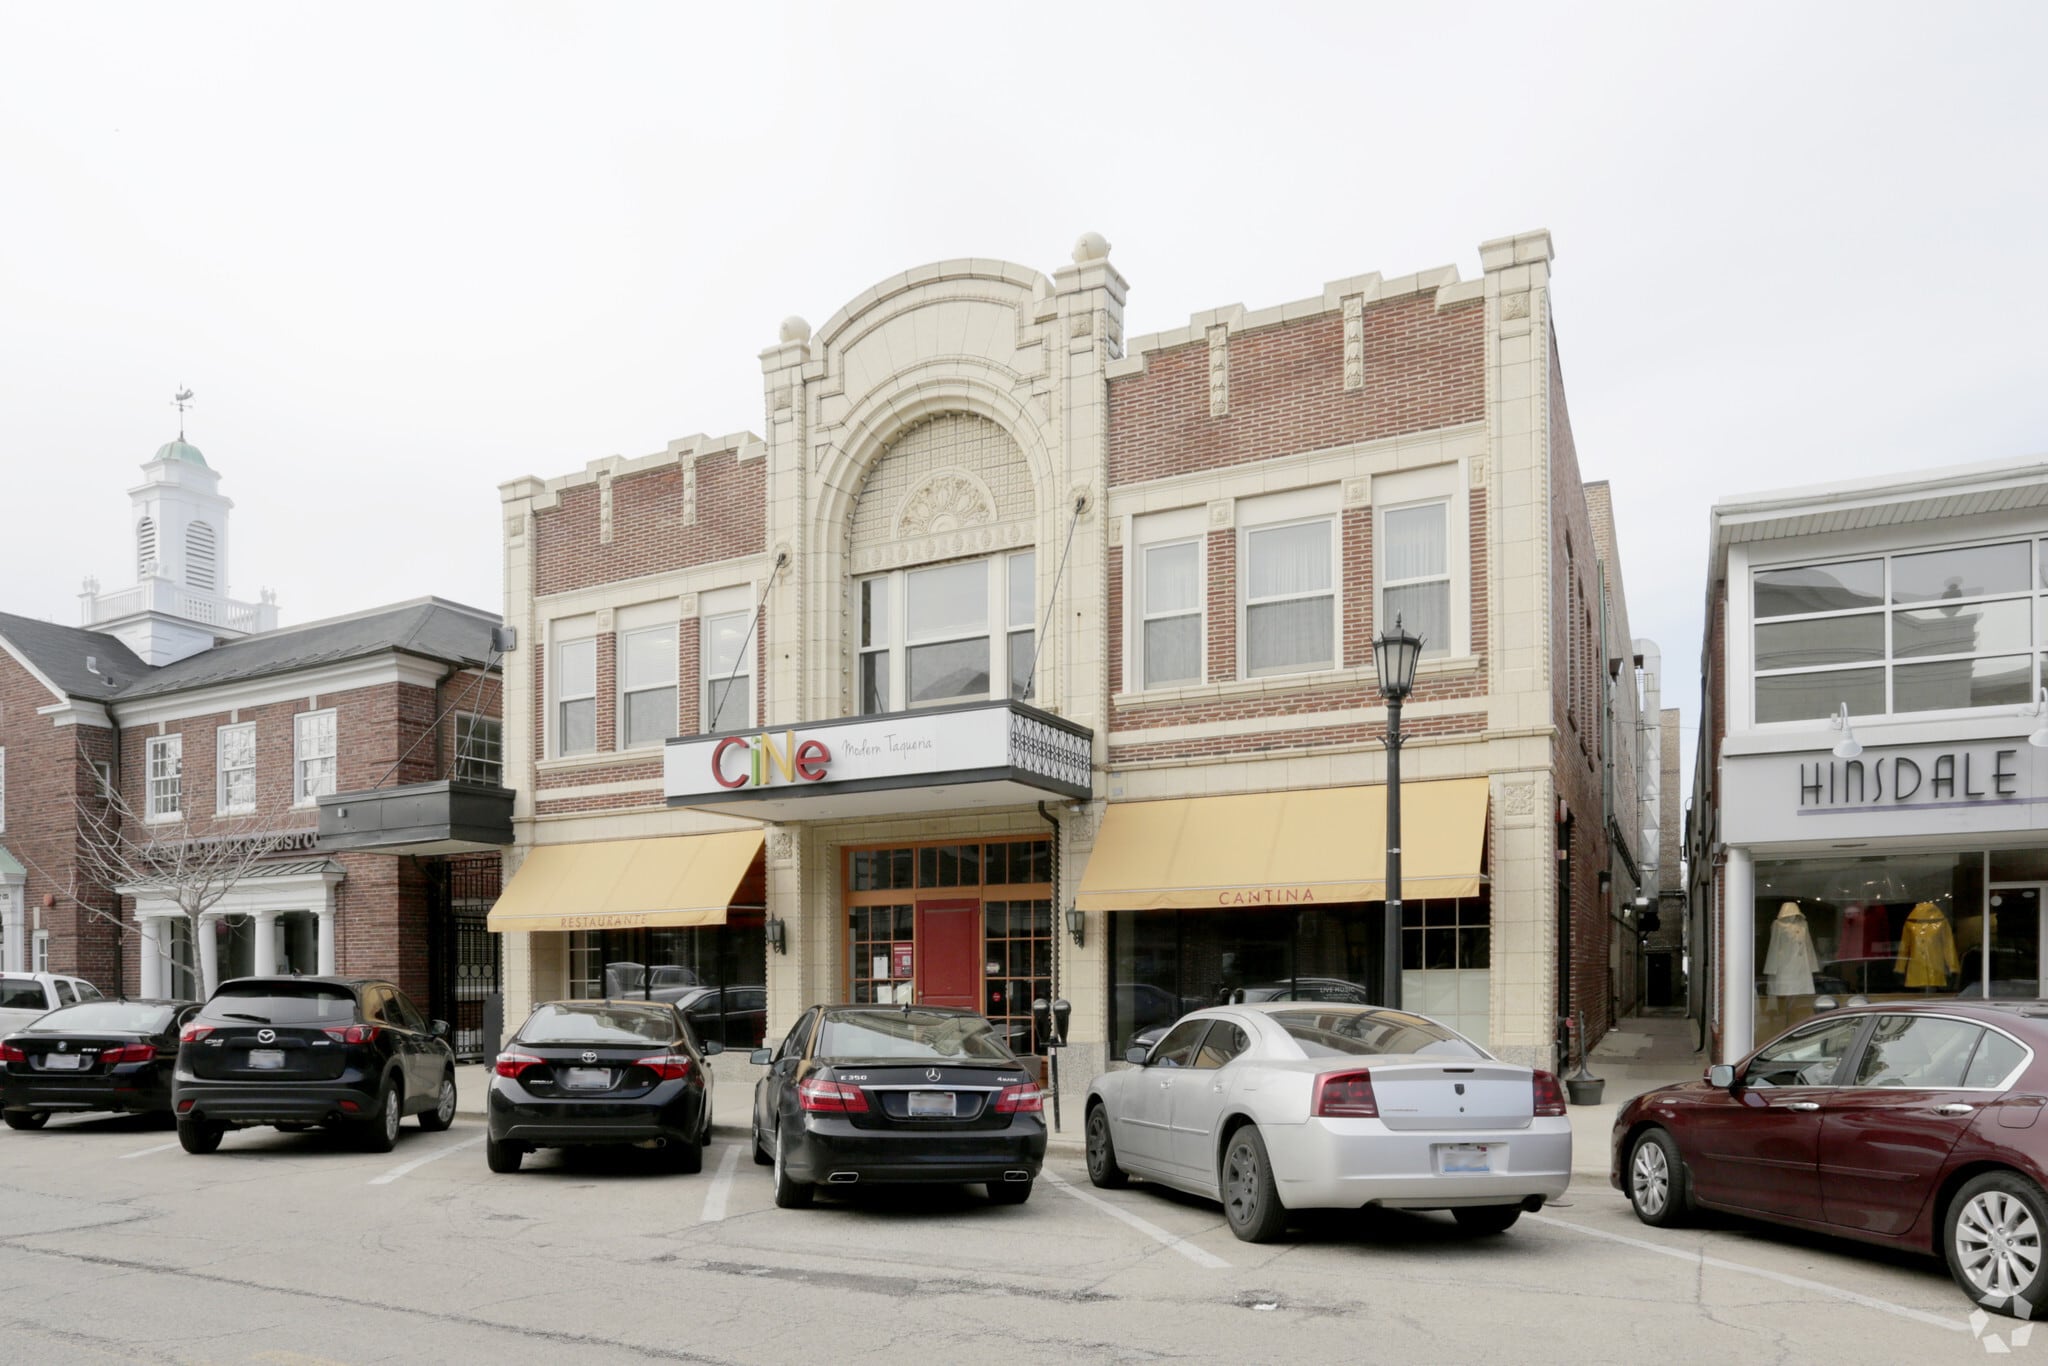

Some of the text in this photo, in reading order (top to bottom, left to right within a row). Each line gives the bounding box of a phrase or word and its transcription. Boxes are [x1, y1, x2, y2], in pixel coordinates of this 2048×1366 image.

[841, 733, 932, 761] Modern Taqueria
[1218, 888, 1314, 905] CANTINA
[560, 914, 648, 929] RESTAURANTE
